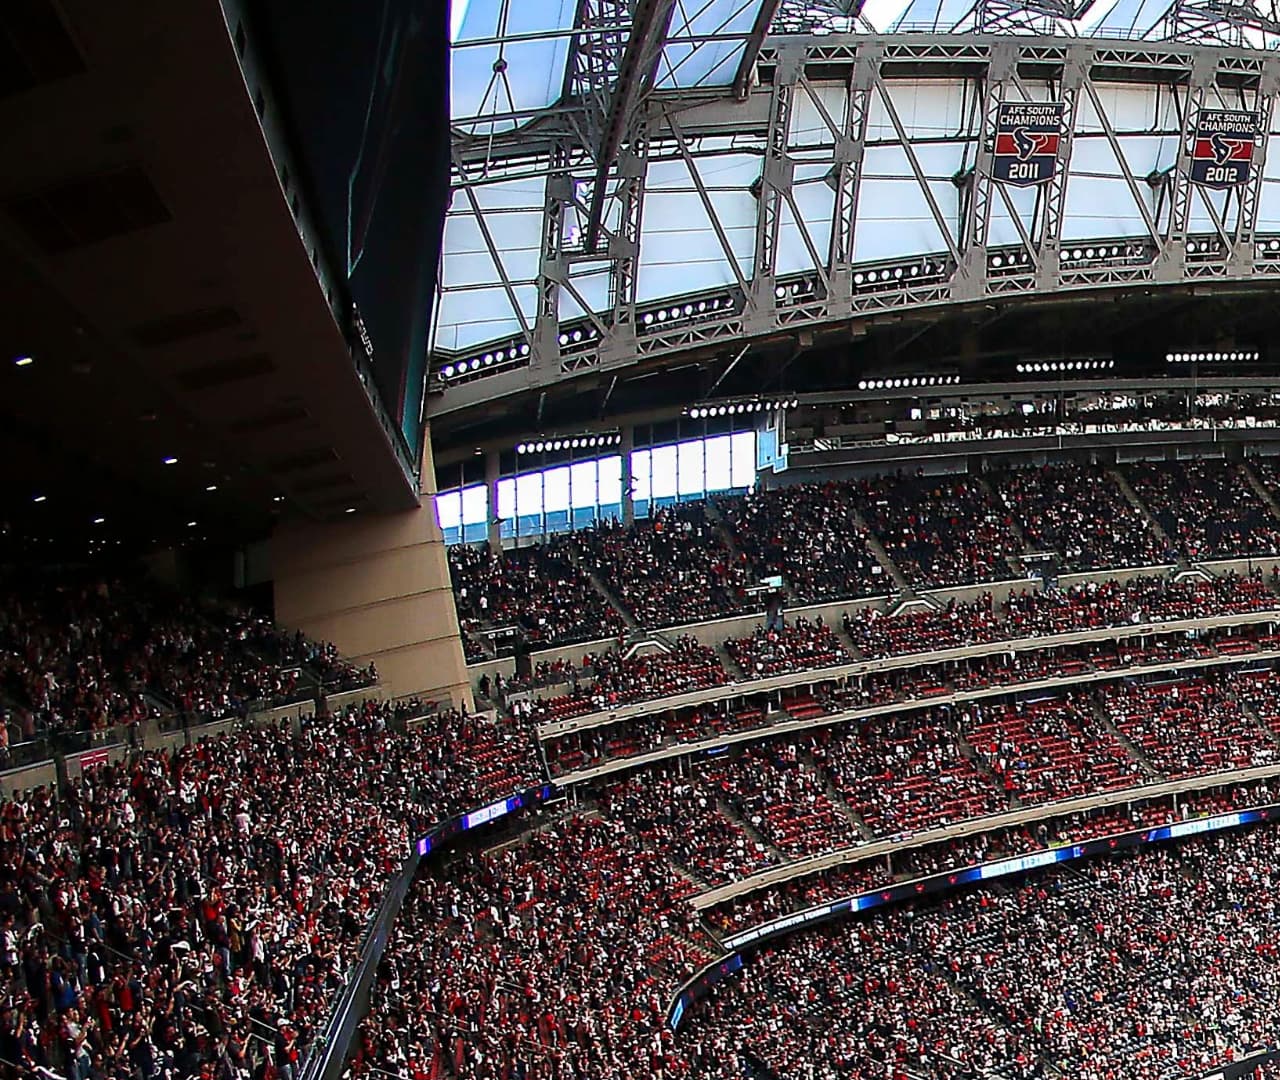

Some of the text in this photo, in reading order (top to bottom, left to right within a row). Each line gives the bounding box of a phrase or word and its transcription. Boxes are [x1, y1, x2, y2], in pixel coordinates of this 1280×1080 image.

[1008, 106, 1056, 115] AFC SOUTH
[1000, 115, 1060, 126] CHAMPIONS
[1207, 113, 1251, 122] AFC SOUTH
[1199, 121, 1255, 133] CHAMPIONS
[1008, 163, 1039, 179] 2011
[1205, 167, 1238, 182] 2012
